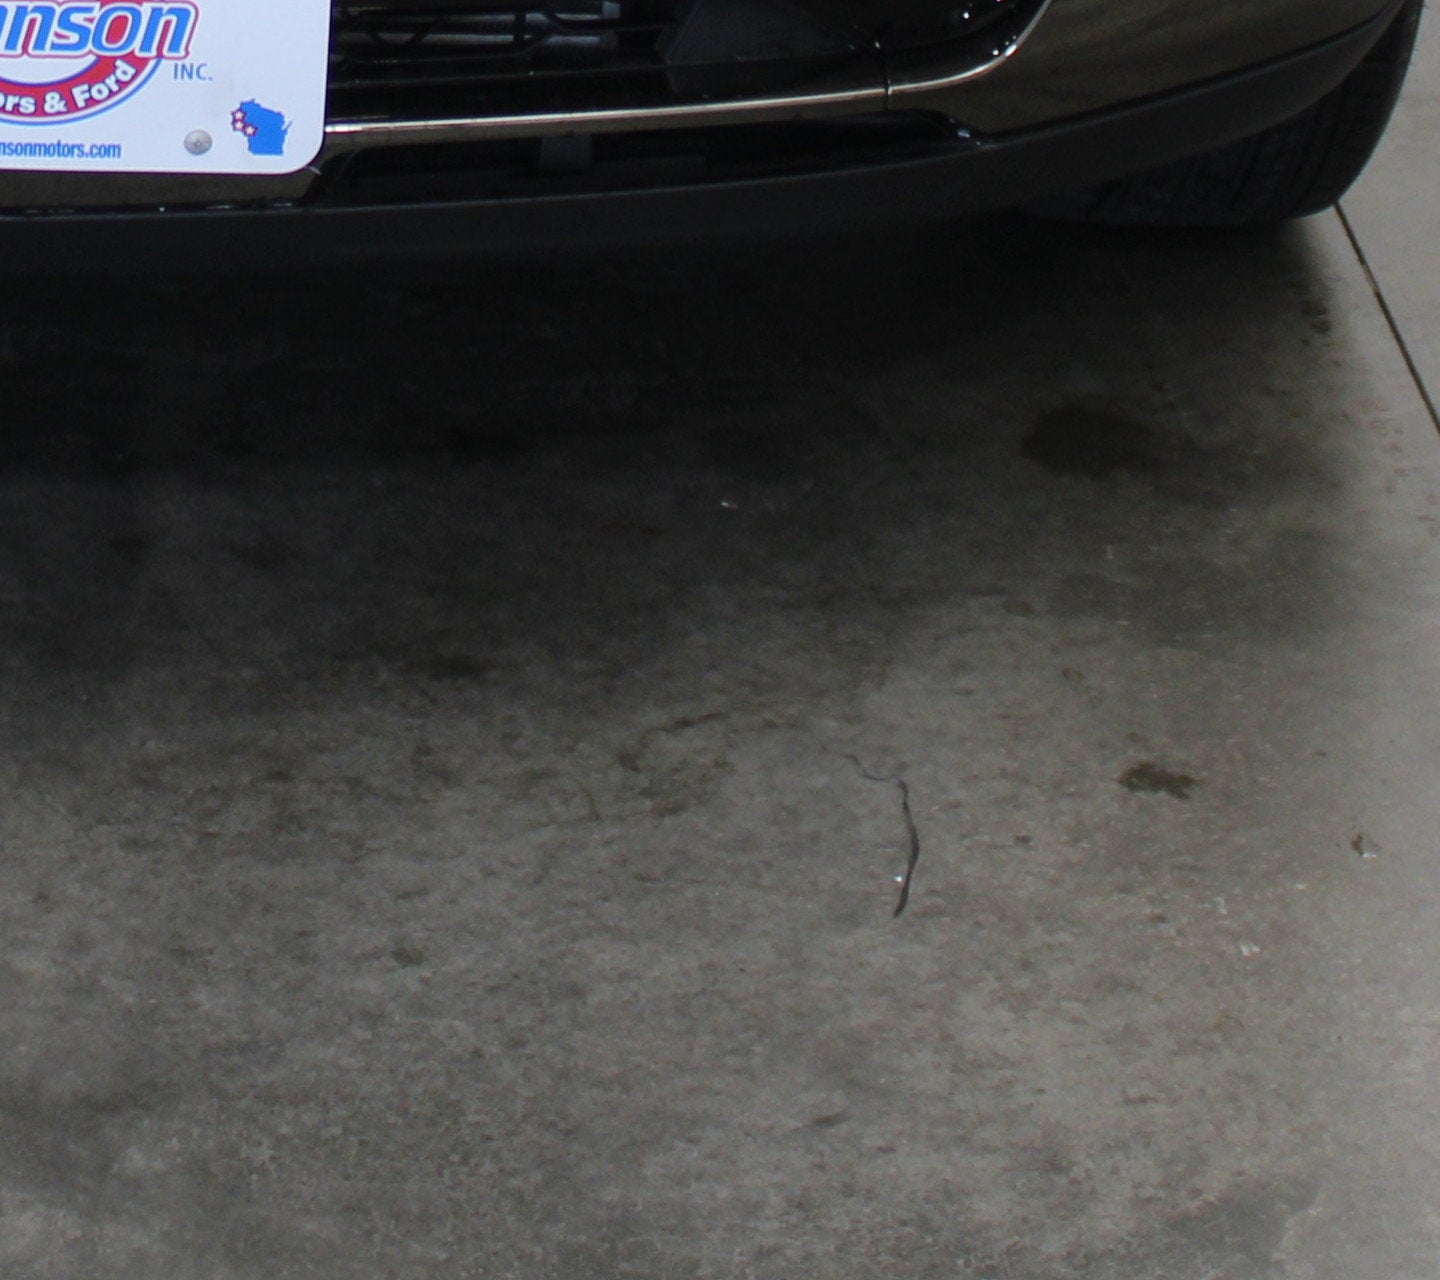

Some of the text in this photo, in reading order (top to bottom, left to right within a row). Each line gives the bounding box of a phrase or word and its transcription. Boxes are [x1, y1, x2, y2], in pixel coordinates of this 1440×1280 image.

[43, 91, 68, 114] &
[71, 59, 137, 109] Ford
[173, 62, 213, 82] INC.
